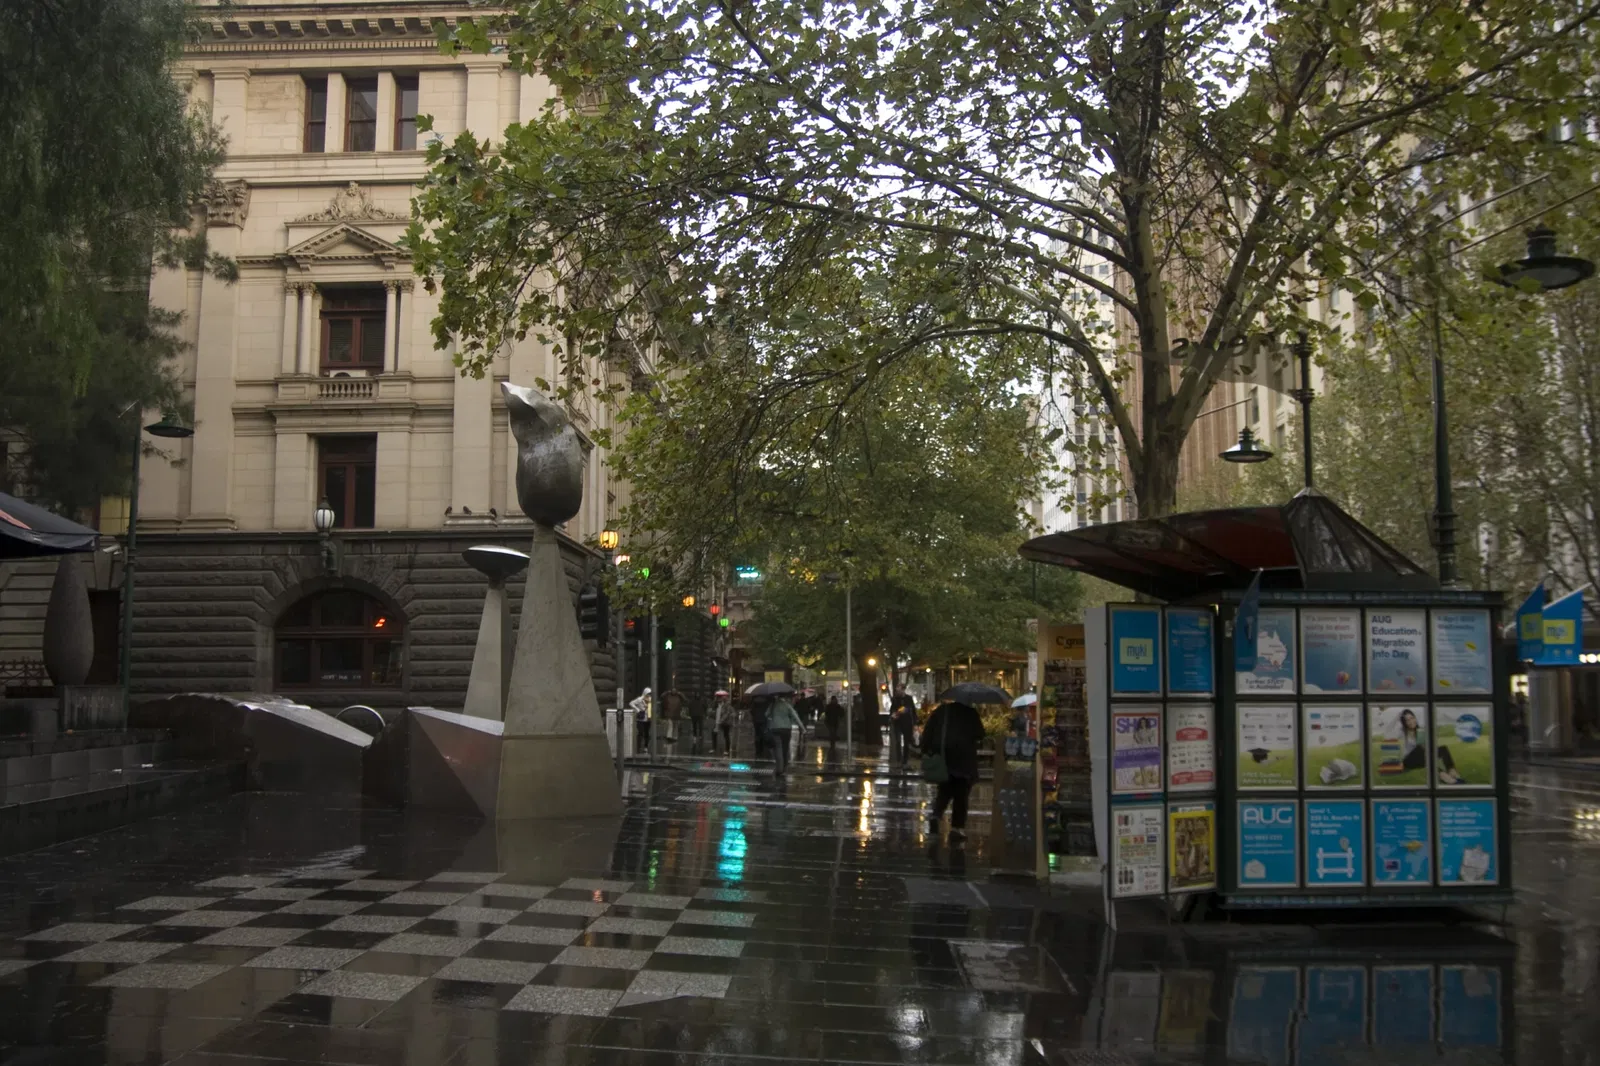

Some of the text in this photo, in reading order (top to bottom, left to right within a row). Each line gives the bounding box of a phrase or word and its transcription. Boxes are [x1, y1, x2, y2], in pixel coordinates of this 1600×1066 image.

[1372, 615, 1392, 623] AUG
[1372, 638, 1415, 648] Migration
[1116, 717, 1157, 733] SHP
[1243, 807, 1293, 825] AUG
